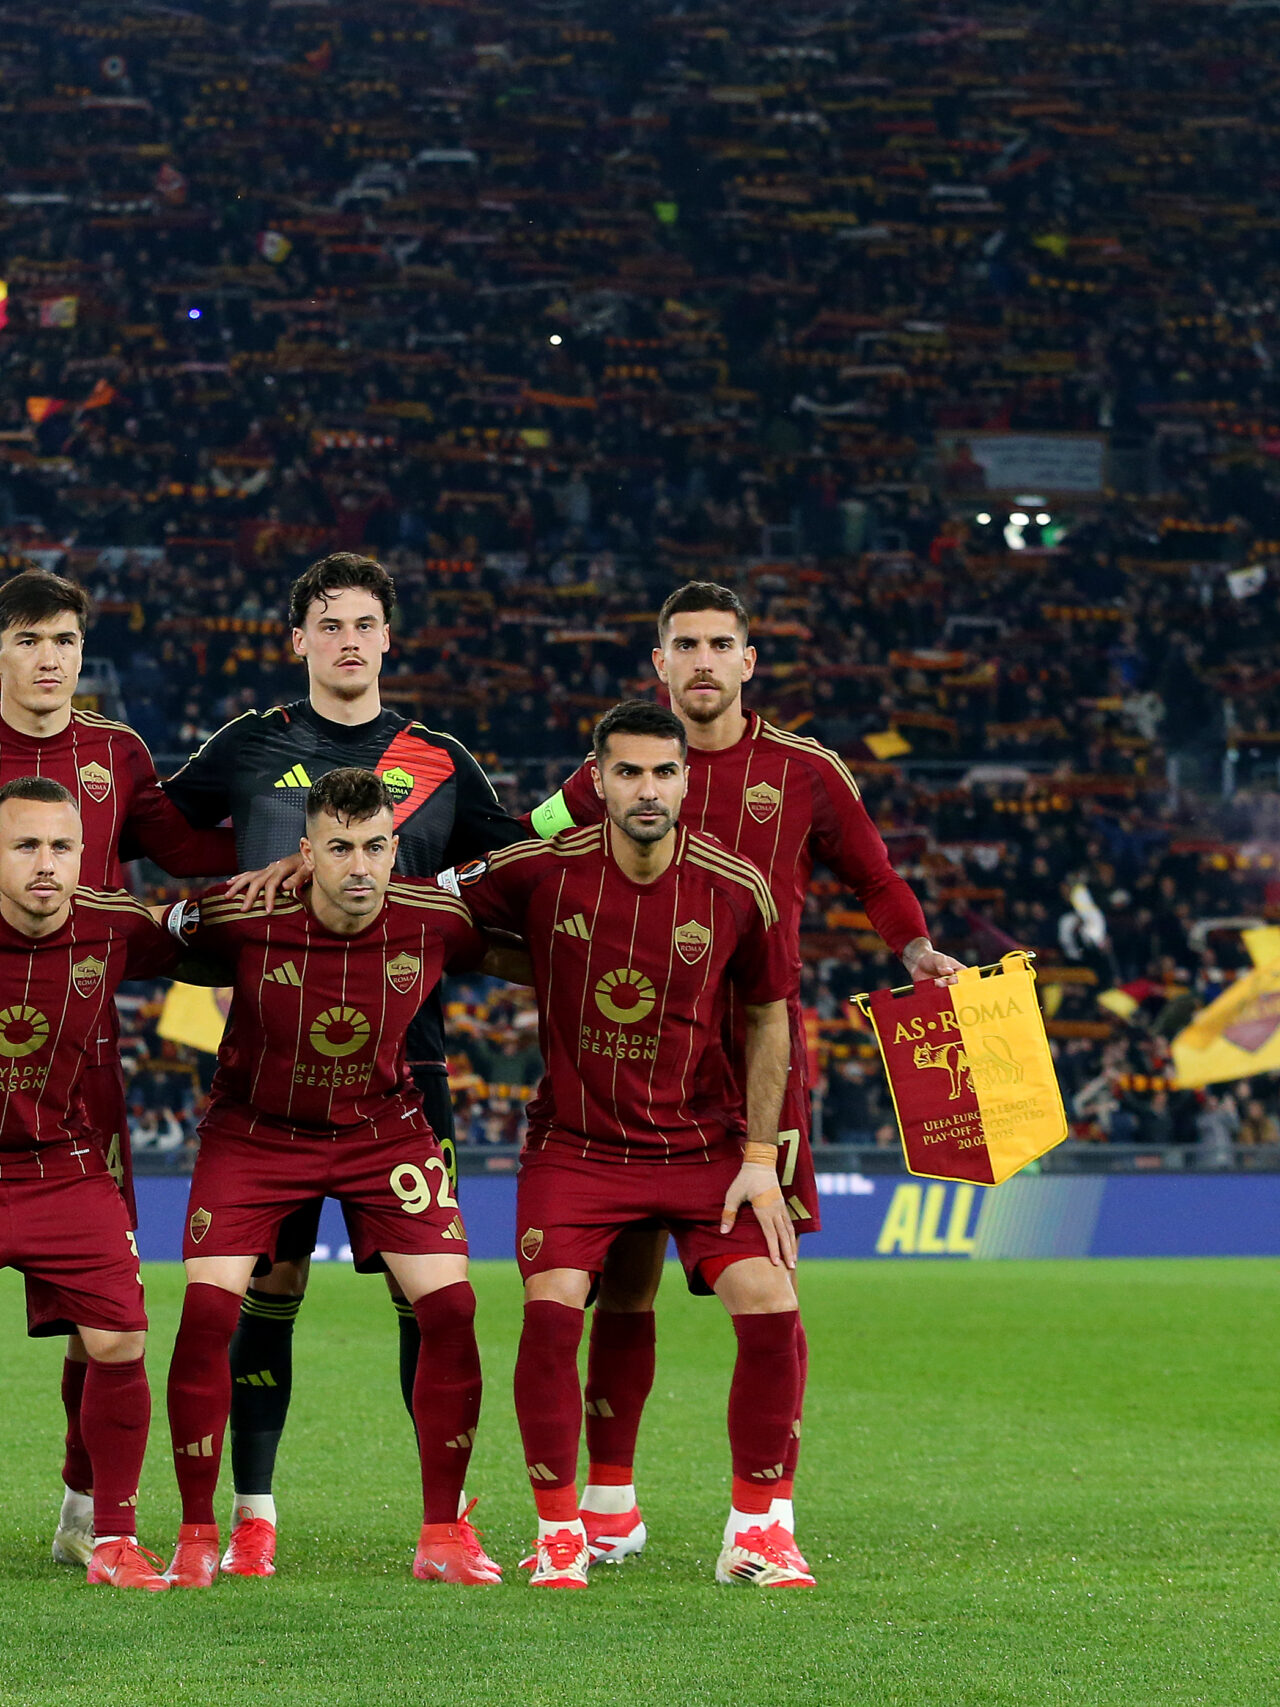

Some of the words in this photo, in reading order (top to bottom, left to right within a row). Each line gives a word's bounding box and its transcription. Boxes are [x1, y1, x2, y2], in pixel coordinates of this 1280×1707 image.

[387, 786, 409, 796] ROMA
[77, 978, 97, 986] ROMA
[393, 975, 414, 983] ROMA
[582, 1025, 659, 1046] RIYADH
[581, 1038, 657, 1060] SEASON
[296, 1061, 373, 1075] RIYADH
[294, 1072, 371, 1087] SEASON
[106, 1133, 124, 1188] 4
[777, 1128, 800, 1187] 7
[389, 1156, 458, 1214] 92
[877, 1183, 977, 1254] ALL
